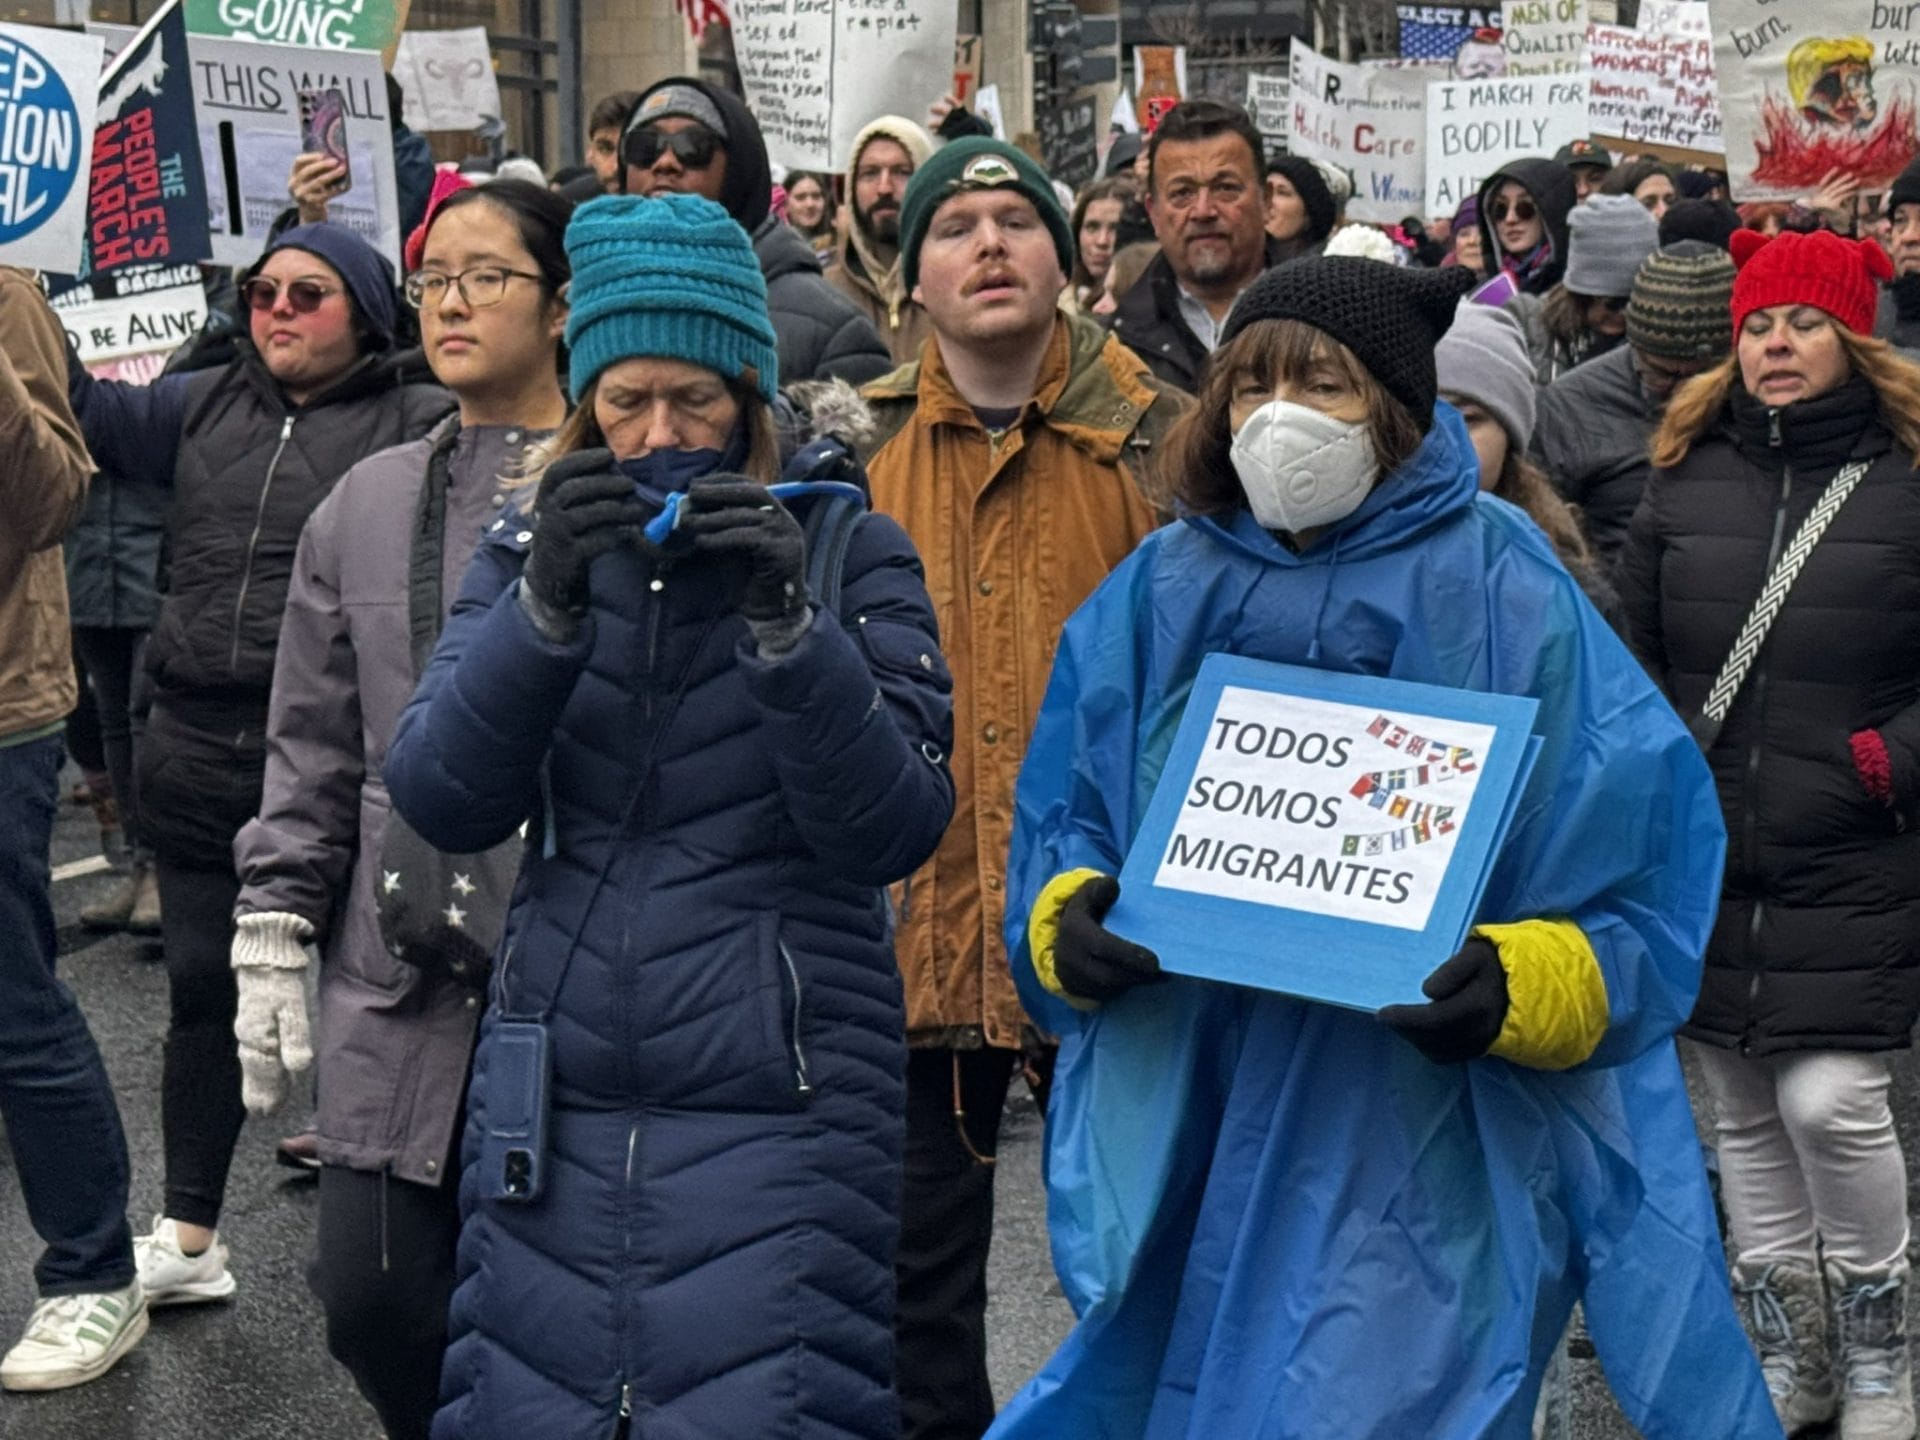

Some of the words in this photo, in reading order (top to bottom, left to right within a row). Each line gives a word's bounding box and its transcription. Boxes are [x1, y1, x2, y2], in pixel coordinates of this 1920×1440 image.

[1511, 6, 1550, 25] MEN
[196, 61, 282, 109] THIS
[1442, 87, 1456, 111] I
[1469, 84, 1533, 108] MARCH
[1548, 83, 1583, 105] FOR
[1354, 123, 1416, 158] Care
[1442, 117, 1550, 156] BODILY
[91, 121, 134, 271] MARCH
[123, 107, 171, 258] PEOPLE'S
[160, 153, 186, 199] THE
[90, 327, 117, 348] BE
[126, 309, 197, 345] ALIVE
[1215, 717, 1353, 769] TODOS
[1187, 776, 1343, 829] SOMOS
[1166, 833, 1415, 905] MIGRANTES
